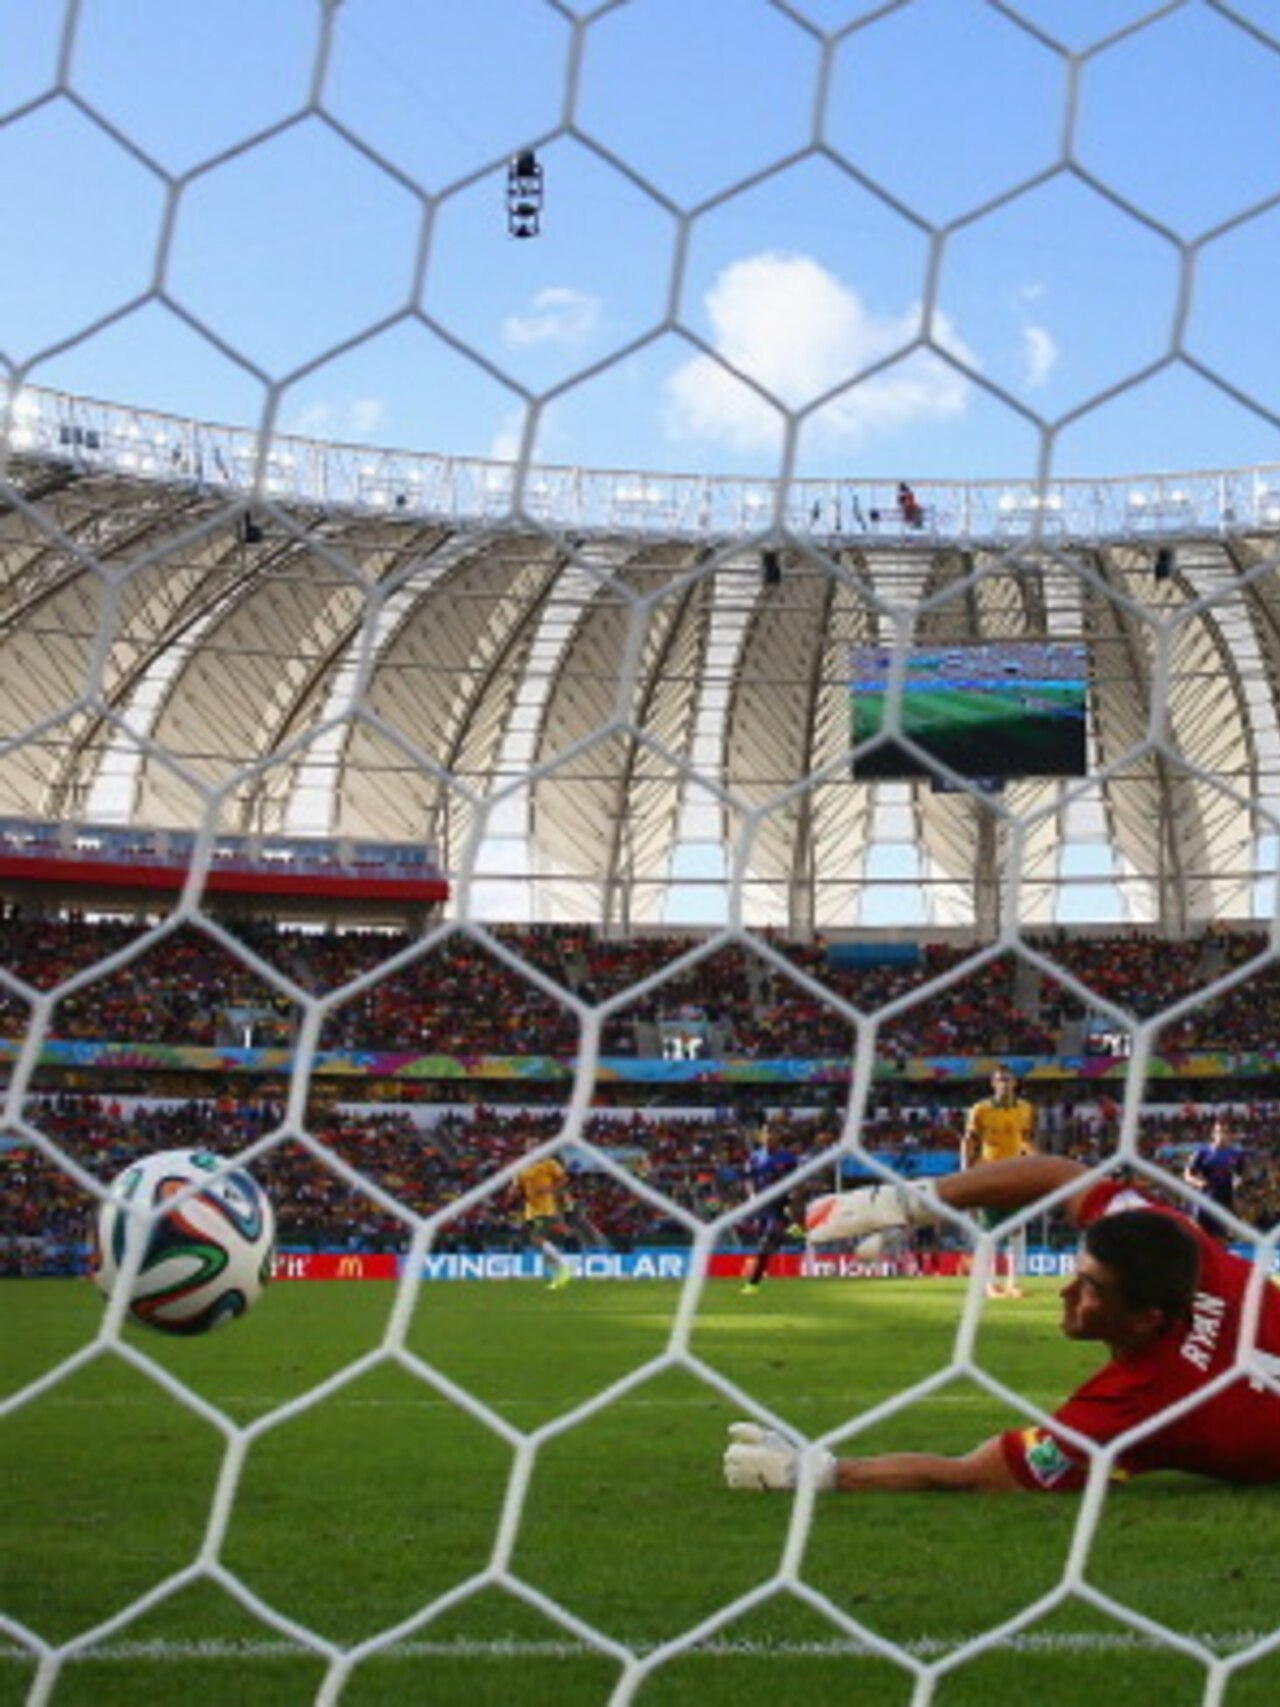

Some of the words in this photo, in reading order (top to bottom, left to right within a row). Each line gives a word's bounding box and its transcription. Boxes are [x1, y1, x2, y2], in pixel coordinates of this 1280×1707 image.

[423, 1254, 544, 1278] YINGLI
[566, 1254, 684, 1278] SOLAR
[1180, 1292, 1226, 1371] RYAN
